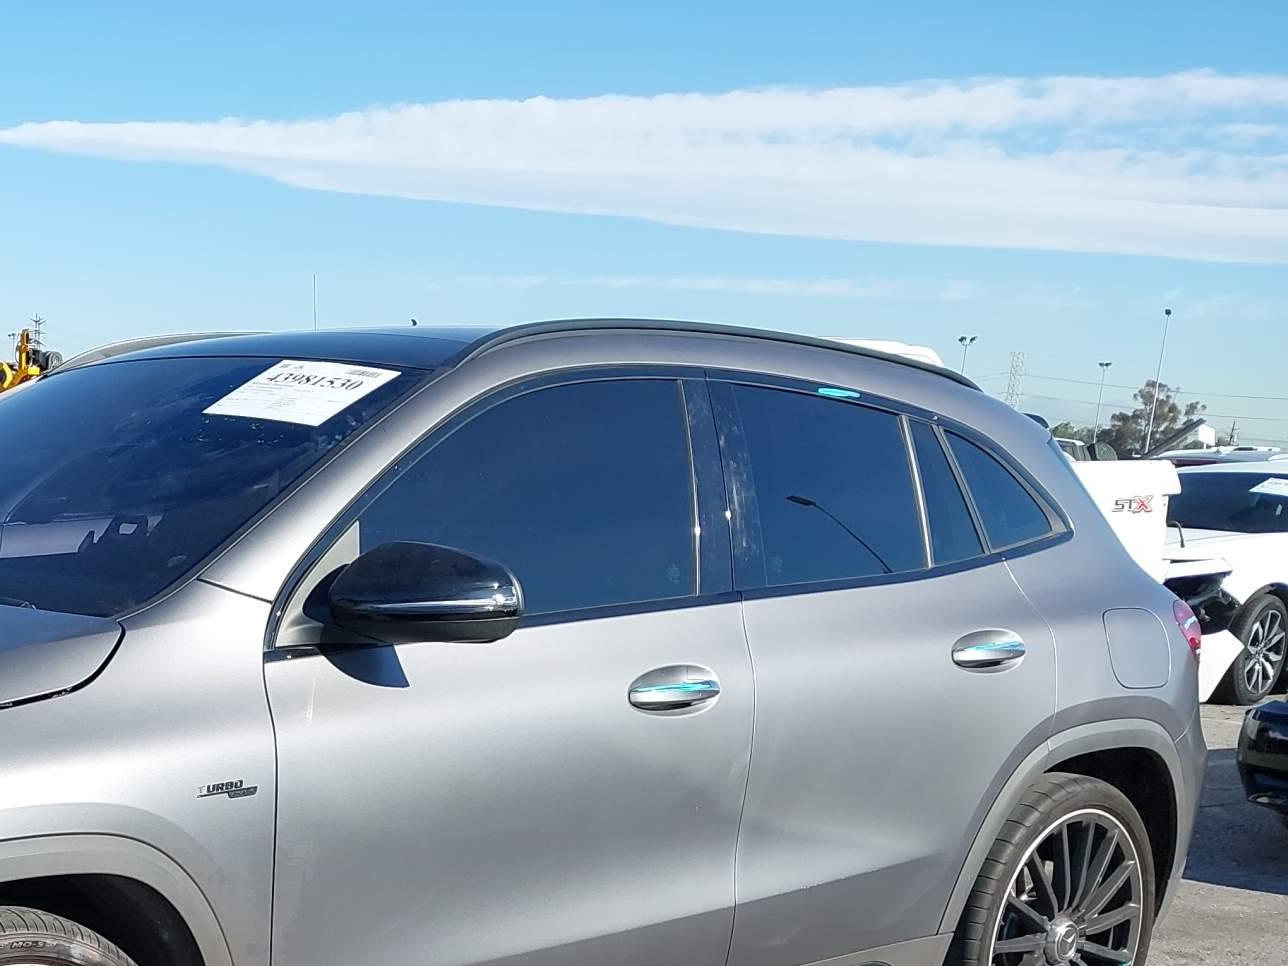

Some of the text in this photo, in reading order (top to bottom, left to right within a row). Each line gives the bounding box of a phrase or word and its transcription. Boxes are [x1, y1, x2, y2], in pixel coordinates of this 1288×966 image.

[266, 372, 364, 391] 43981530
[1112, 495, 1153, 513] STX
[198, 780, 243, 793] TURBO
